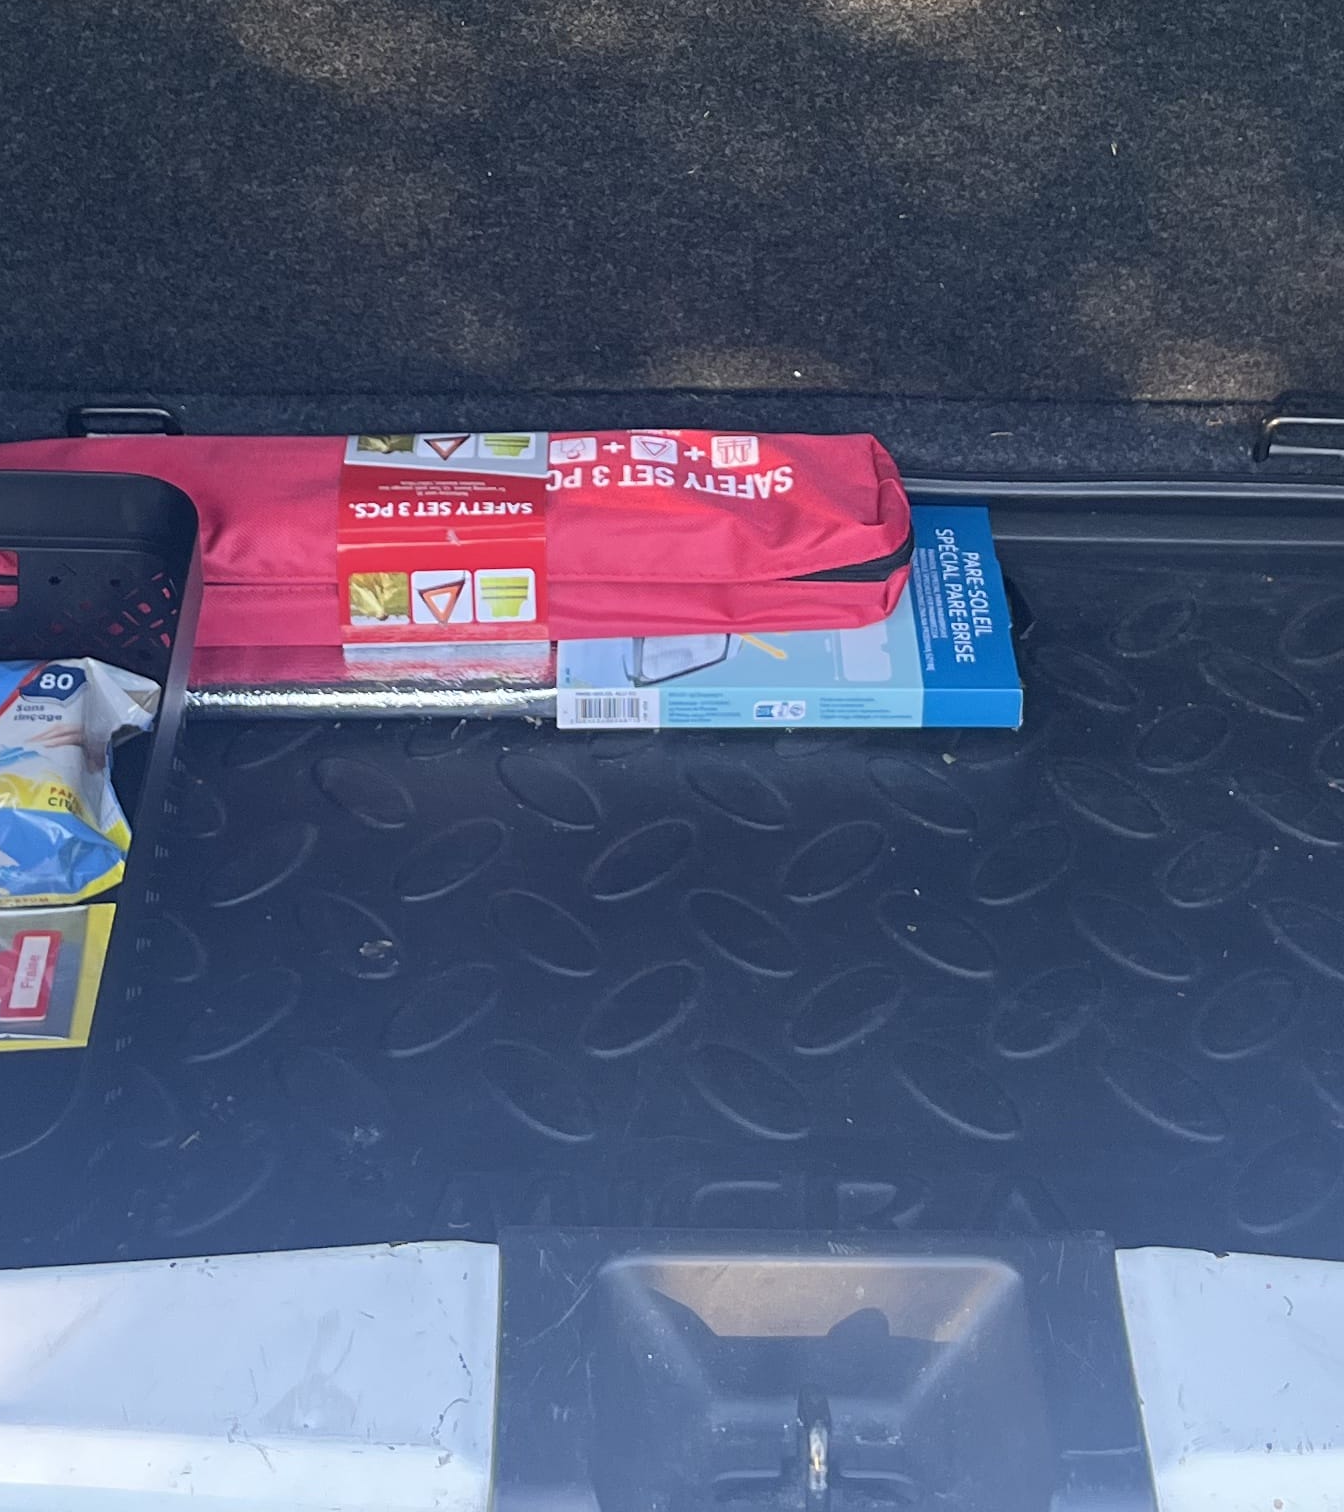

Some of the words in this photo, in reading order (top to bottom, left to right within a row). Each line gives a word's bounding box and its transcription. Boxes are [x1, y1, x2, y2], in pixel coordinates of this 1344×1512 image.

[592, 465, 611, 486] 3
[617, 464, 675, 487] SET
[683, 466, 793, 499] SAFETY
[348, 502, 394, 519] PCS.
[398, 501, 411, 517] 3
[413, 501, 452, 517] SET
[455, 501, 533, 516] SAFETY
[935, 528, 960, 581] SPÉCIAL
[961, 551, 993, 637] PARE-SOLEIL
[945, 582, 976, 663] PARE-BRISE
[39, 673, 74, 690] 80
